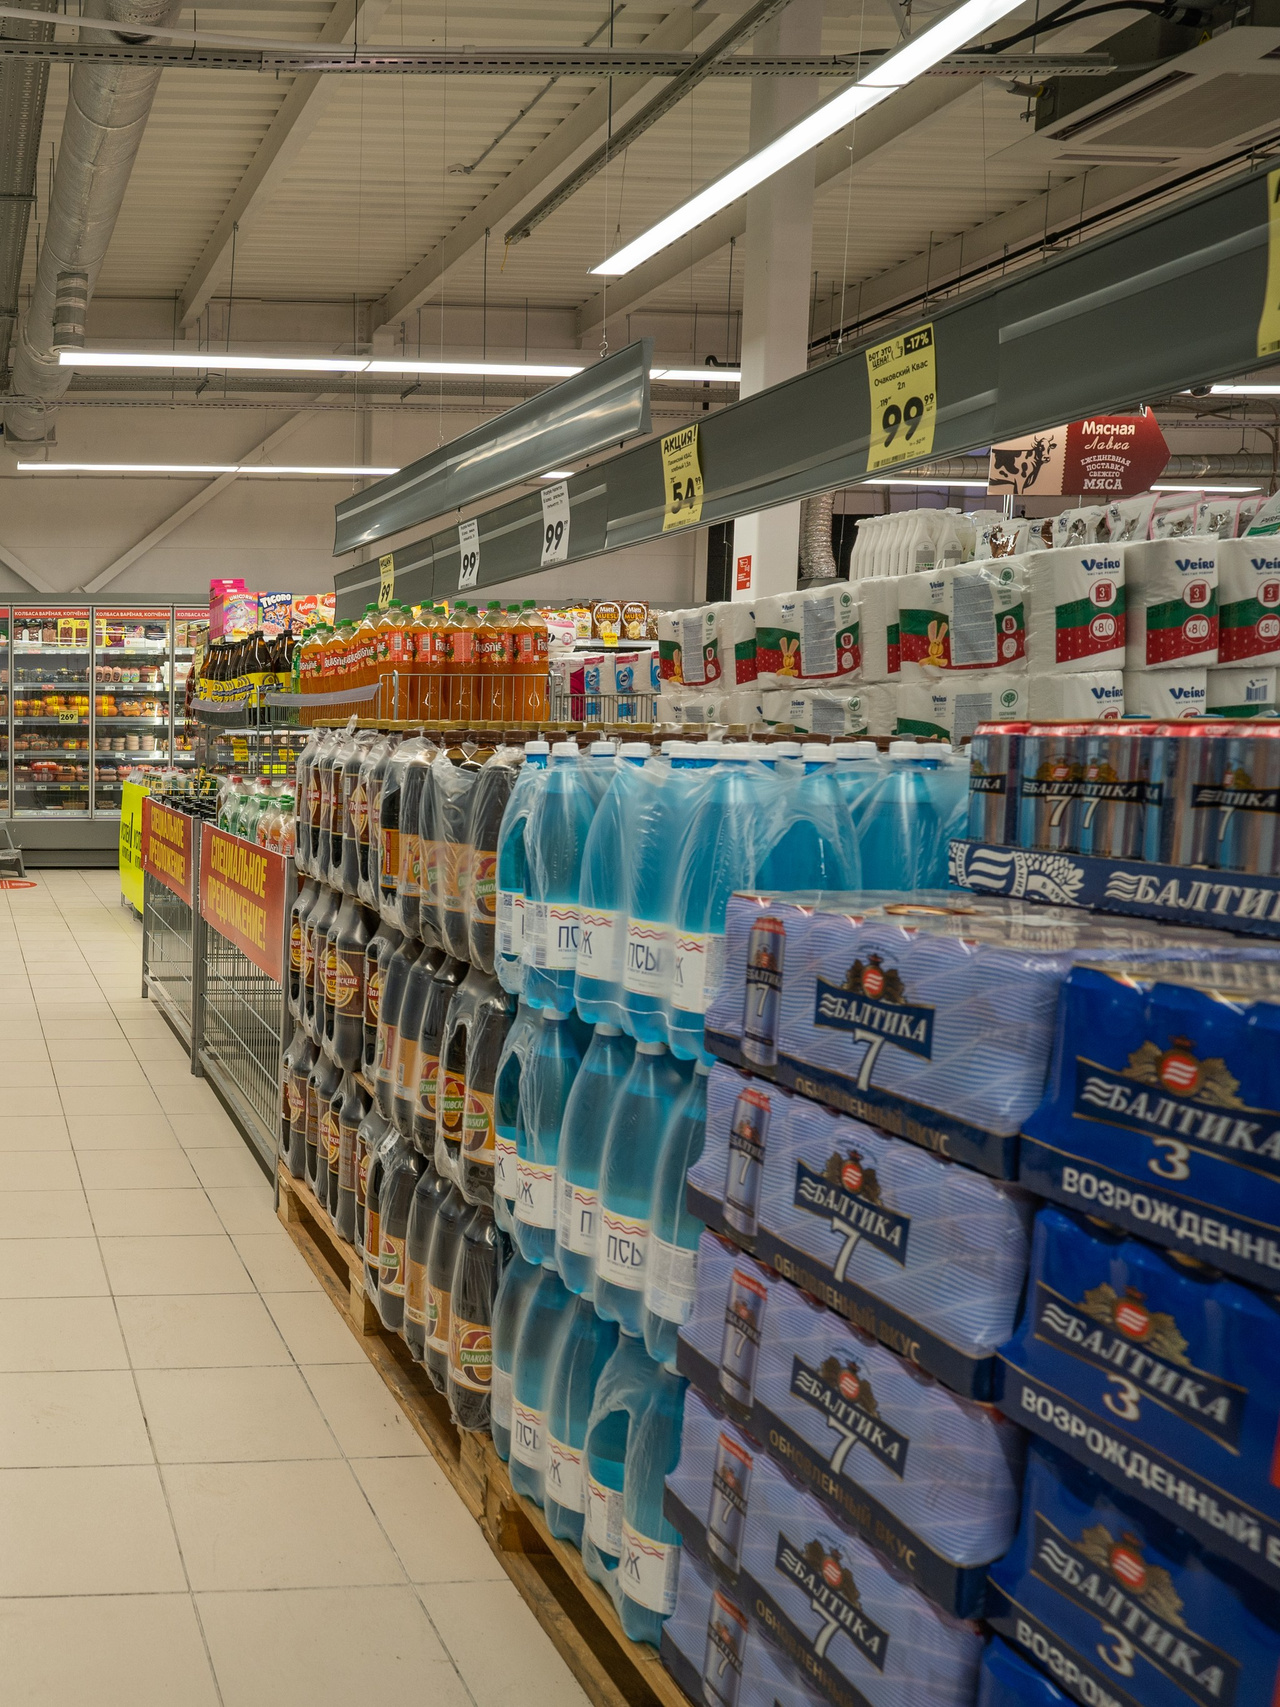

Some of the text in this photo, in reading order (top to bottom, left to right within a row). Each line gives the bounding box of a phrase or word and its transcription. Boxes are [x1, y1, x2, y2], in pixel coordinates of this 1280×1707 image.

[868, 345, 892, 362] ВОТ ЭТО
[906, 331, 929, 350] -17%
[872, 355, 889, 368] ЦЕНА!
[874, 359, 929, 387] Очаковский Квас
[897, 381, 906, 391] 2л
[882, 393, 935, 448] 99 99
[1082, 421, 1136, 435] Мясная
[663, 425, 697, 455] АКЦИЯ!
[1084, 436, 1130, 451] Лавка
[1080, 454, 1132, 467] ЕЖЕДНЕВНАЯ
[1086, 463, 1125, 473] ПОСТАВКА
[671, 477, 696, 514] 54
[1083, 478, 1123, 490] МЯСА
[545, 520, 564, 553] 99
[462, 551, 476, 579] 99
[1081, 558, 1121, 572] Veiro
[1175, 558, 1215, 572] Veiro
[382, 585, 391, 603] 99
[1099, 587, 1105, 598] 3
[1193, 588, 1200, 599] 3
[1267, 587, 1274, 598] 3
[1169, 687, 1205, 700] Veiro
[150, 805, 184, 849] СПЕЦИАЛЬНОЕ
[1046, 795, 1073, 827] 7
[1082, 797, 1101, 829] 7
[1218, 806, 1236, 842] 7
[148, 835, 186, 887] ПРЕДЛОЖЕНИЕ!
[210, 834, 268, 899] СПЕЦИАЛЬНОЕ
[207, 875, 267, 952] ПРЕДЛОЖЕНИЕ!
[756, 983, 770, 1018] 7
[833, 998, 928, 1044] БАЛТИКА
[853, 1028, 886, 1092] 7
[906, 1120, 951, 1157] ВКУС
[1106, 1084, 1280, 1161] БАЛТИКА
[738, 1151, 752, 1186] 7
[1148, 1138, 1191, 1181] 3
[812, 1184, 904, 1247] БАЛТИКА
[831, 1216, 862, 1284] 7
[733, 1328, 747, 1358] 7
[879, 1319, 921, 1365] ВКУС
[1065, 1314, 1232, 1425] БАЛТИКА
[1102, 1372, 1141, 1422] 3
[810, 1381, 900, 1462] БАЛТИКА
[826, 1416, 859, 1475] 7
[1021, 1386, 1261, 1552] ВОЗРОЖДЕННЫЙ
[721, 1494, 735, 1524] 7
[769, 1429, 916, 1571] ОБНОВЛЕННЫЙ ВКУС
[792, 1561, 881, 1655] БАЛТИКА
[811, 1599, 841, 1659] 7
[1061, 1555, 1225, 1698] БАЛТИКА
[718, 1653, 731, 1678] 7
[1096, 1622, 1136, 1679] 3
